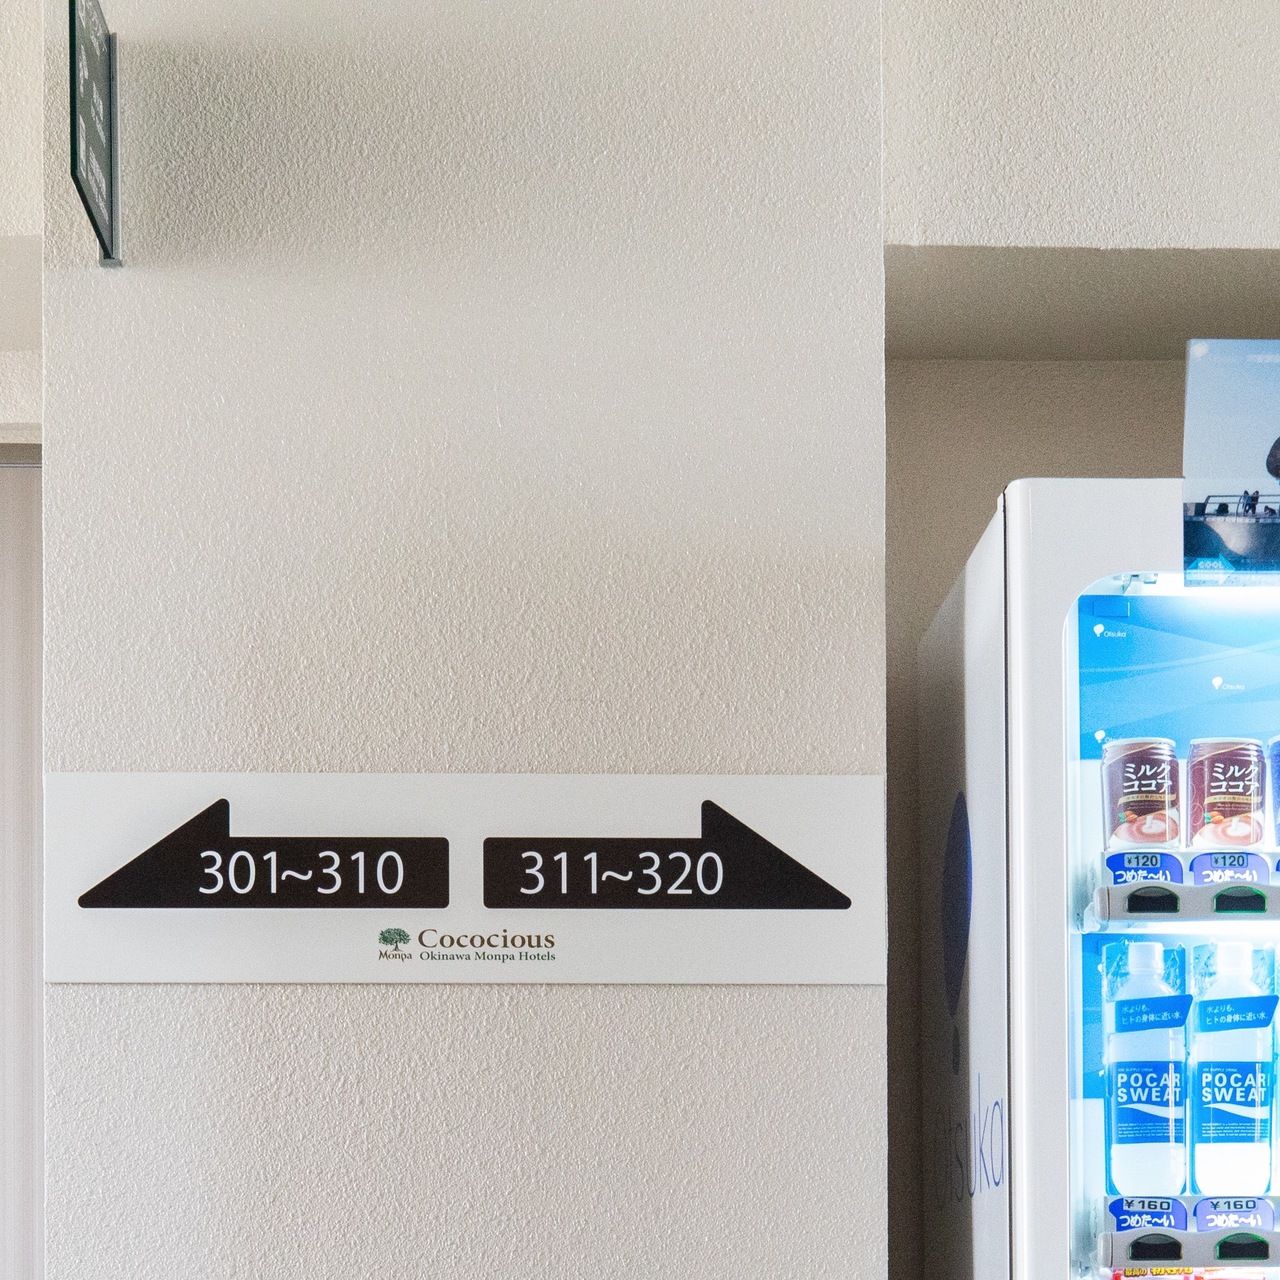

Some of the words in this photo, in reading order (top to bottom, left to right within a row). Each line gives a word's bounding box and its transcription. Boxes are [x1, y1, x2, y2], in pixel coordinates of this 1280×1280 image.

[1124, 763, 1171, 780] ミルク
[1212, 763, 1259, 780] ミルク
[1123, 779, 1172, 793] ココア
[1210, 779, 1260, 794] ココア
[1127, 855, 1158, 867] ¥120
[1214, 855, 1245, 867] ¥120
[198, 851, 405, 895] 301~310
[519, 851, 724, 896] 311~320
[417, 927, 556, 949] Cococious
[378, 949, 413, 962] Monpa
[419, 950, 472, 961] Okinawa
[474, 950, 516, 964] Monpa
[519, 949, 557, 961] Hotels
[1117, 1087, 1182, 1102] SWEAT
[1201, 1087, 1267, 1102] SWEAT
[1124, 1199, 1170, 1210] ¥160
[1210, 1199, 1257, 1210] ¥160
